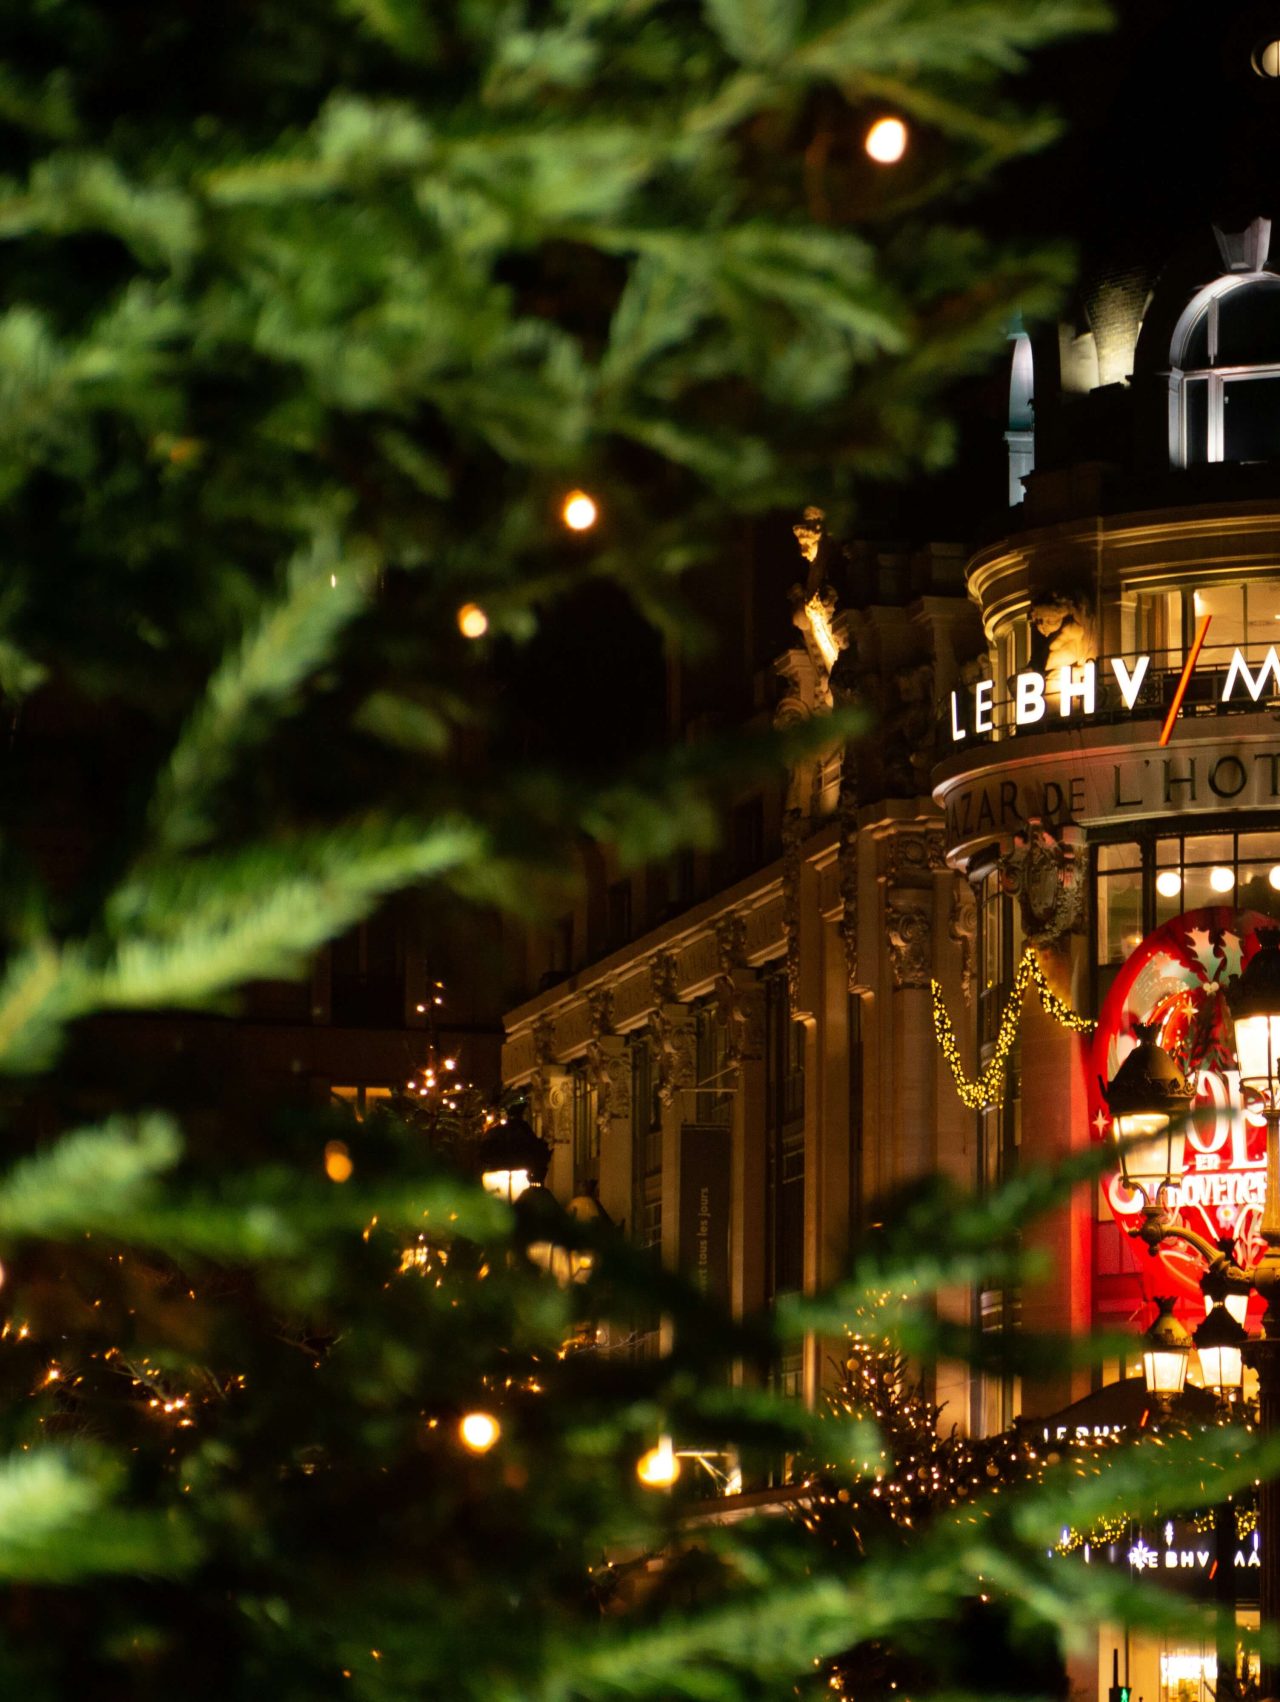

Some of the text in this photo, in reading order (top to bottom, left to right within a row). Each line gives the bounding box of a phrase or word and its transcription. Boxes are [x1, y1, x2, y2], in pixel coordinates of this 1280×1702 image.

[951, 679, 994, 741] LE
[1016, 655, 1150, 725] BHV
[946, 779, 1023, 840] AZAR
[1043, 777, 1086, 816] DE
[699, 1186, 711, 1218] jours
[696, 1219, 708, 1237] les
[697, 1240, 708, 1266] tous
[1165, 1551, 1210, 1568] BHV
